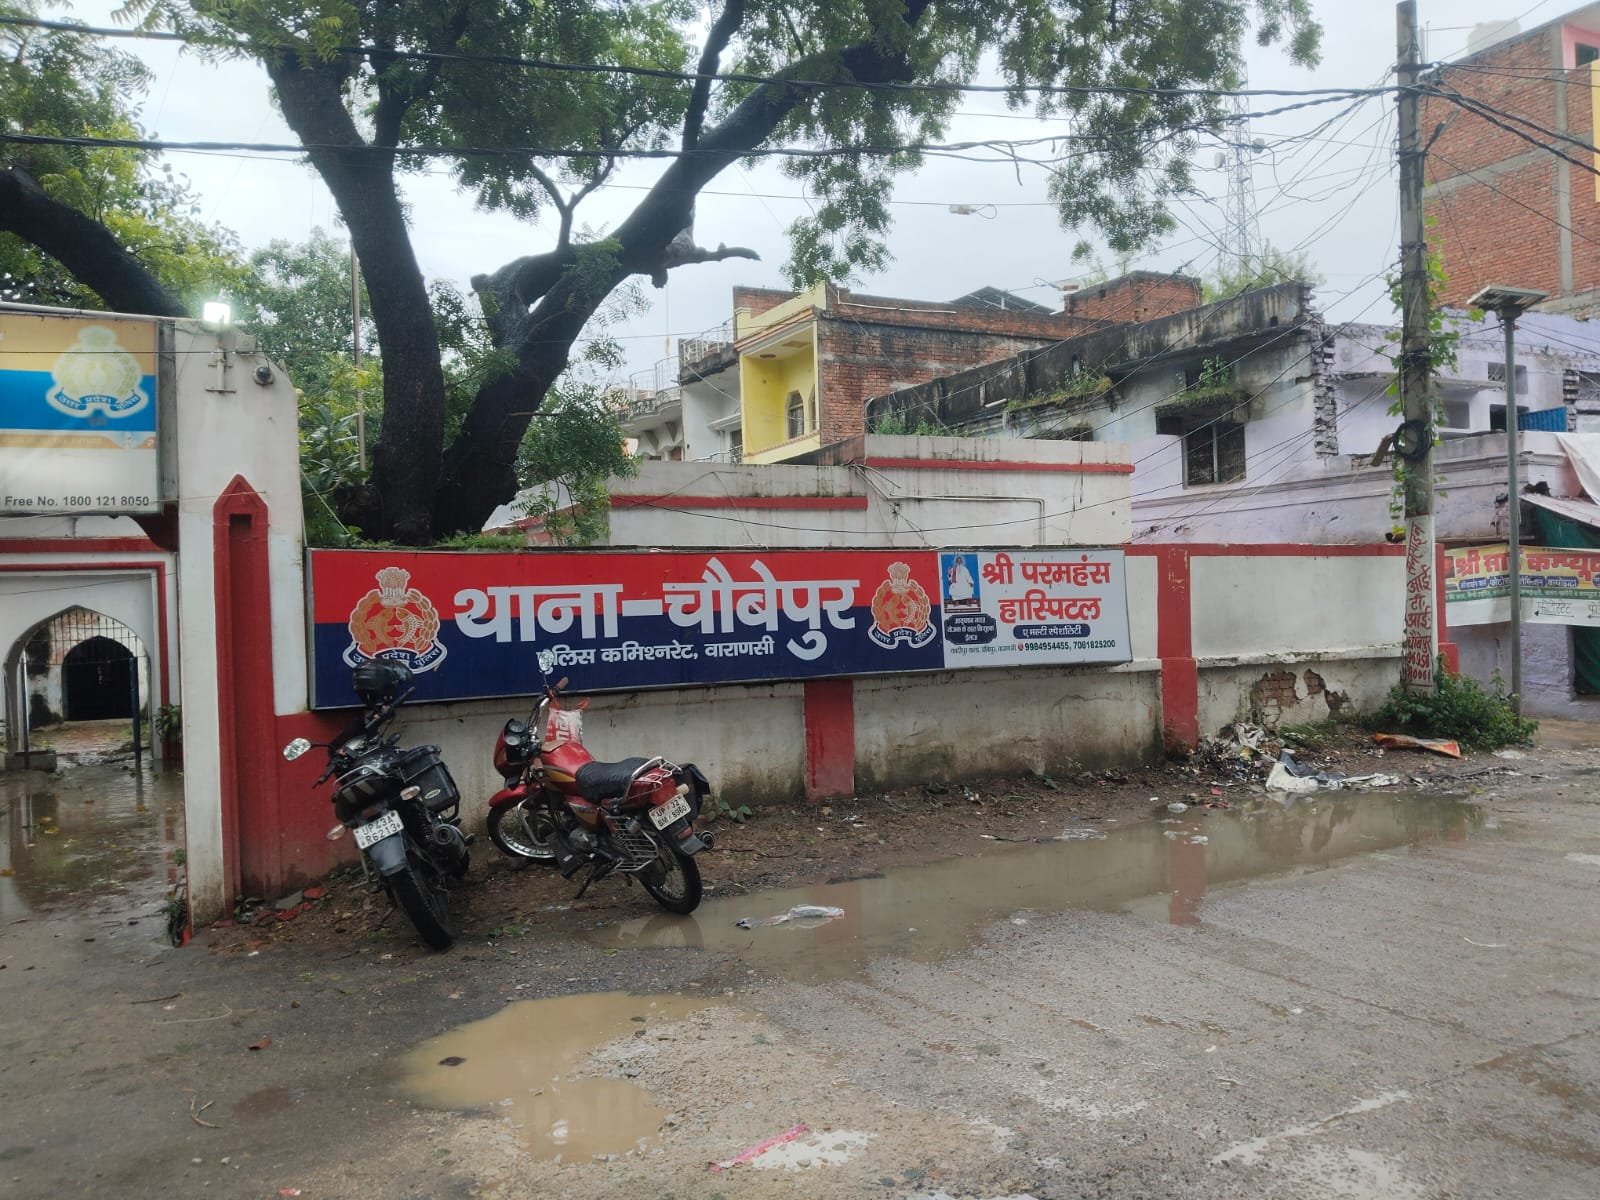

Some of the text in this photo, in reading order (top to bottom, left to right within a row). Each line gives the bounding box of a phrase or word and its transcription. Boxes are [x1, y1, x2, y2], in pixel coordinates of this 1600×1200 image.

[5, 496, 149, 506] Free No. 1800 121 8050
[982, 553, 1111, 586] श्री परमहंस
[1455, 548, 1480, 577] श्री
[998, 589, 1102, 624] हास्पिटल
[704, 635, 775, 658] वाराणसी
